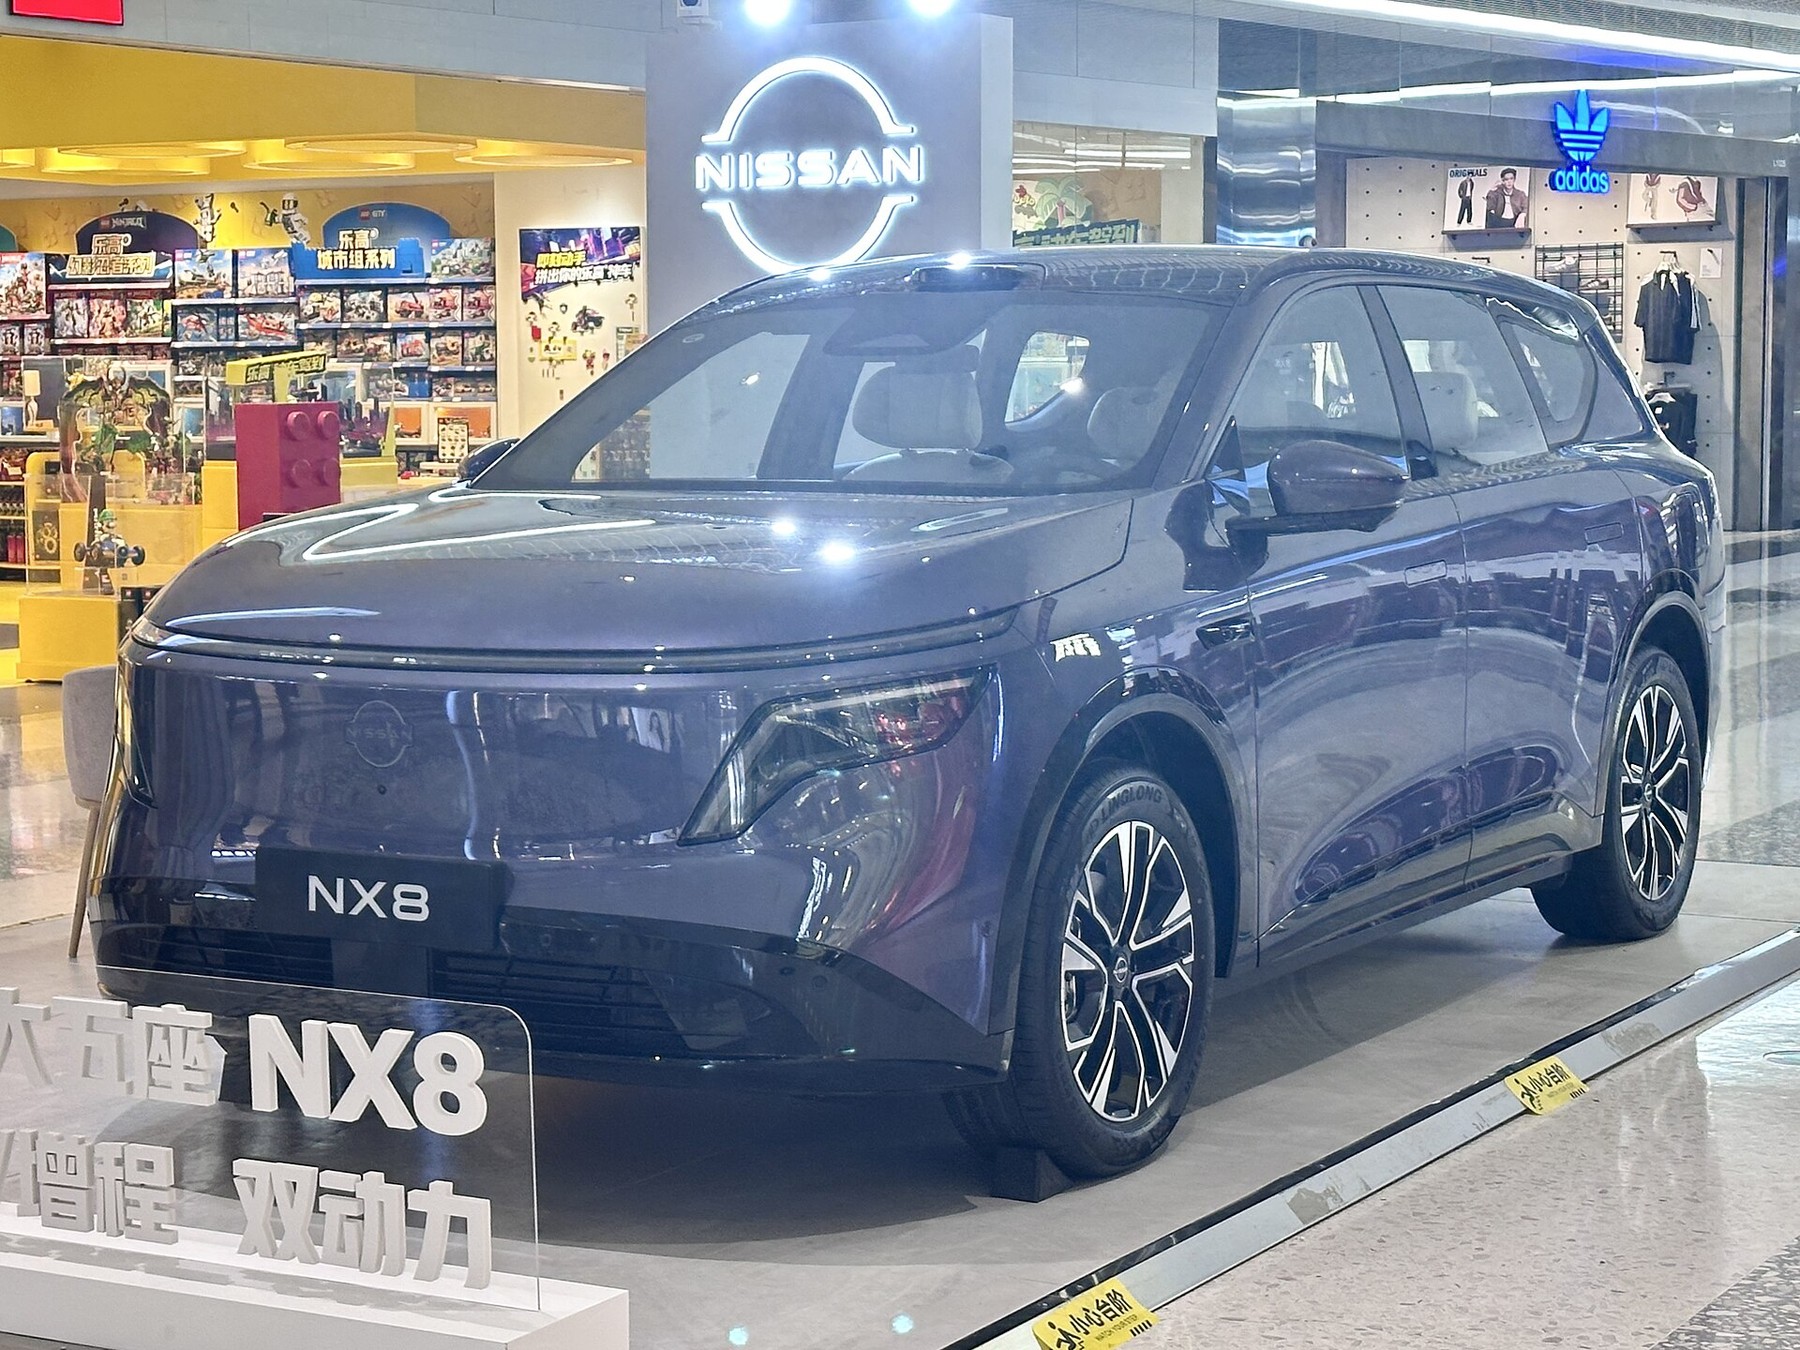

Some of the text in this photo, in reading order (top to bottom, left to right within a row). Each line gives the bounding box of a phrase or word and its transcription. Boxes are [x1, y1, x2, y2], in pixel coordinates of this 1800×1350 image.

[694, 146, 922, 190] NISSAN
[1553, 165, 1609, 193] adidas
[317, 248, 396, 270] 城市组系列
[1100, 784, 1163, 822] LINGLONG
[307, 874, 431, 922] NX8
[248, 1013, 488, 1137] NX8
[1528, 1062, 1572, 1092] 小心台阶
[232, 1157, 493, 1290] 双动力
[1069, 1289, 1133, 1335] 小心台阶
